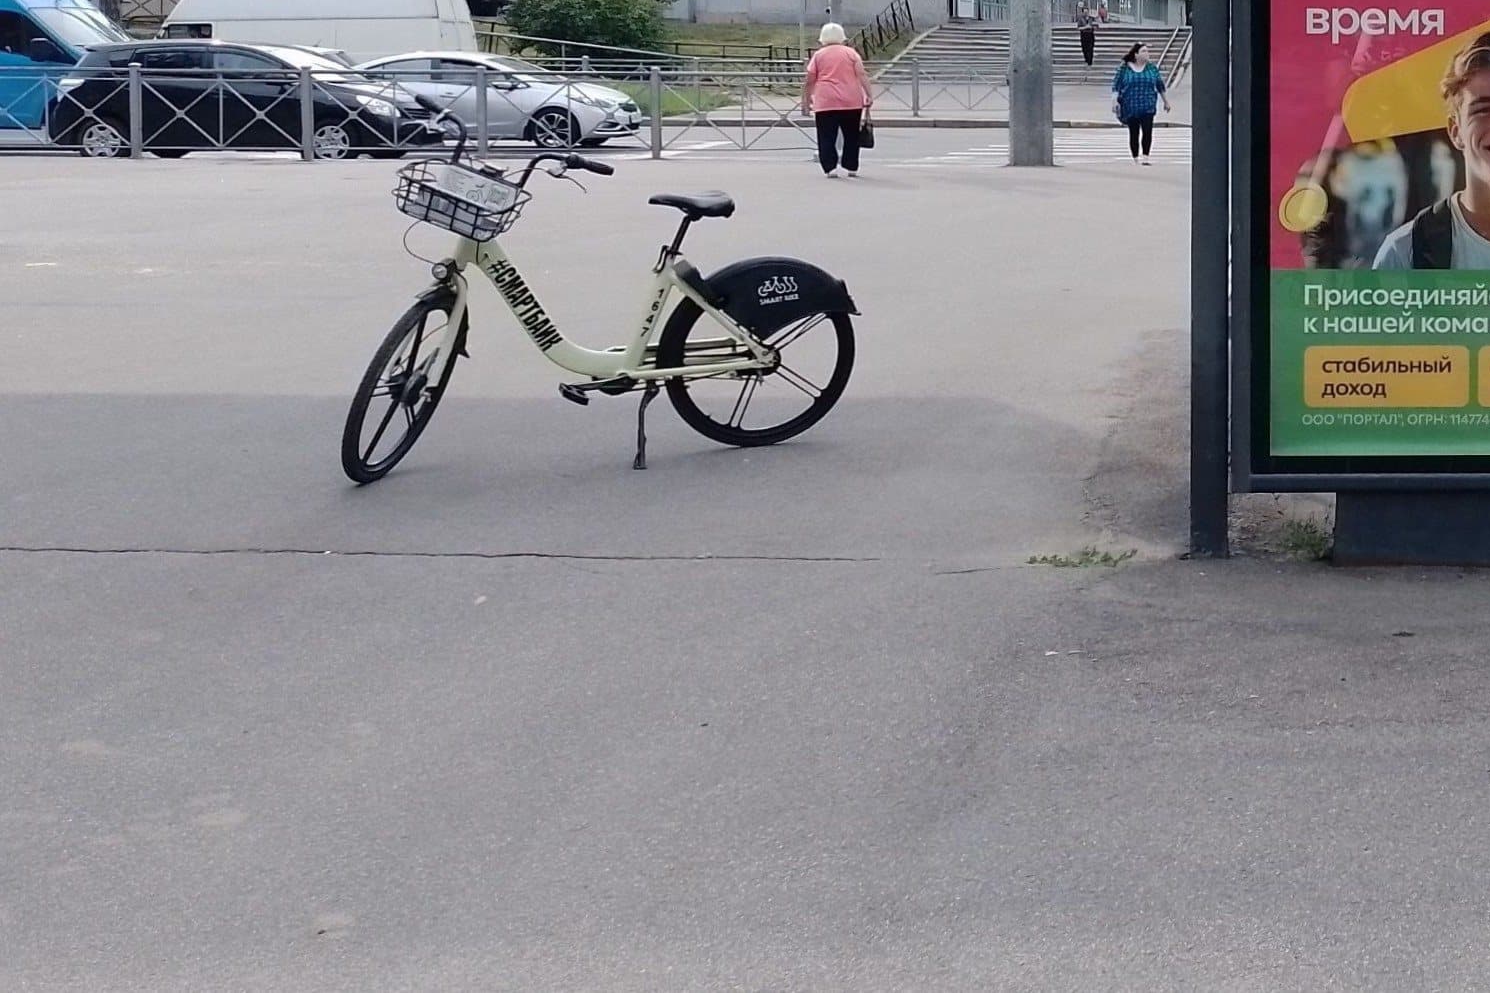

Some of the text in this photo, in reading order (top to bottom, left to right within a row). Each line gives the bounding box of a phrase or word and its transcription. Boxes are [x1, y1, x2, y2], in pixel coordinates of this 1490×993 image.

[1305, 7, 1445, 44] время
[759, 295, 783, 306] SMART
[1303, 316, 1319, 334] к
[1323, 311, 1415, 334] нашей
[1321, 355, 1453, 375] стабильный
[1321, 382, 1388, 399] доход
[1302, 413, 1335, 426] ООО
